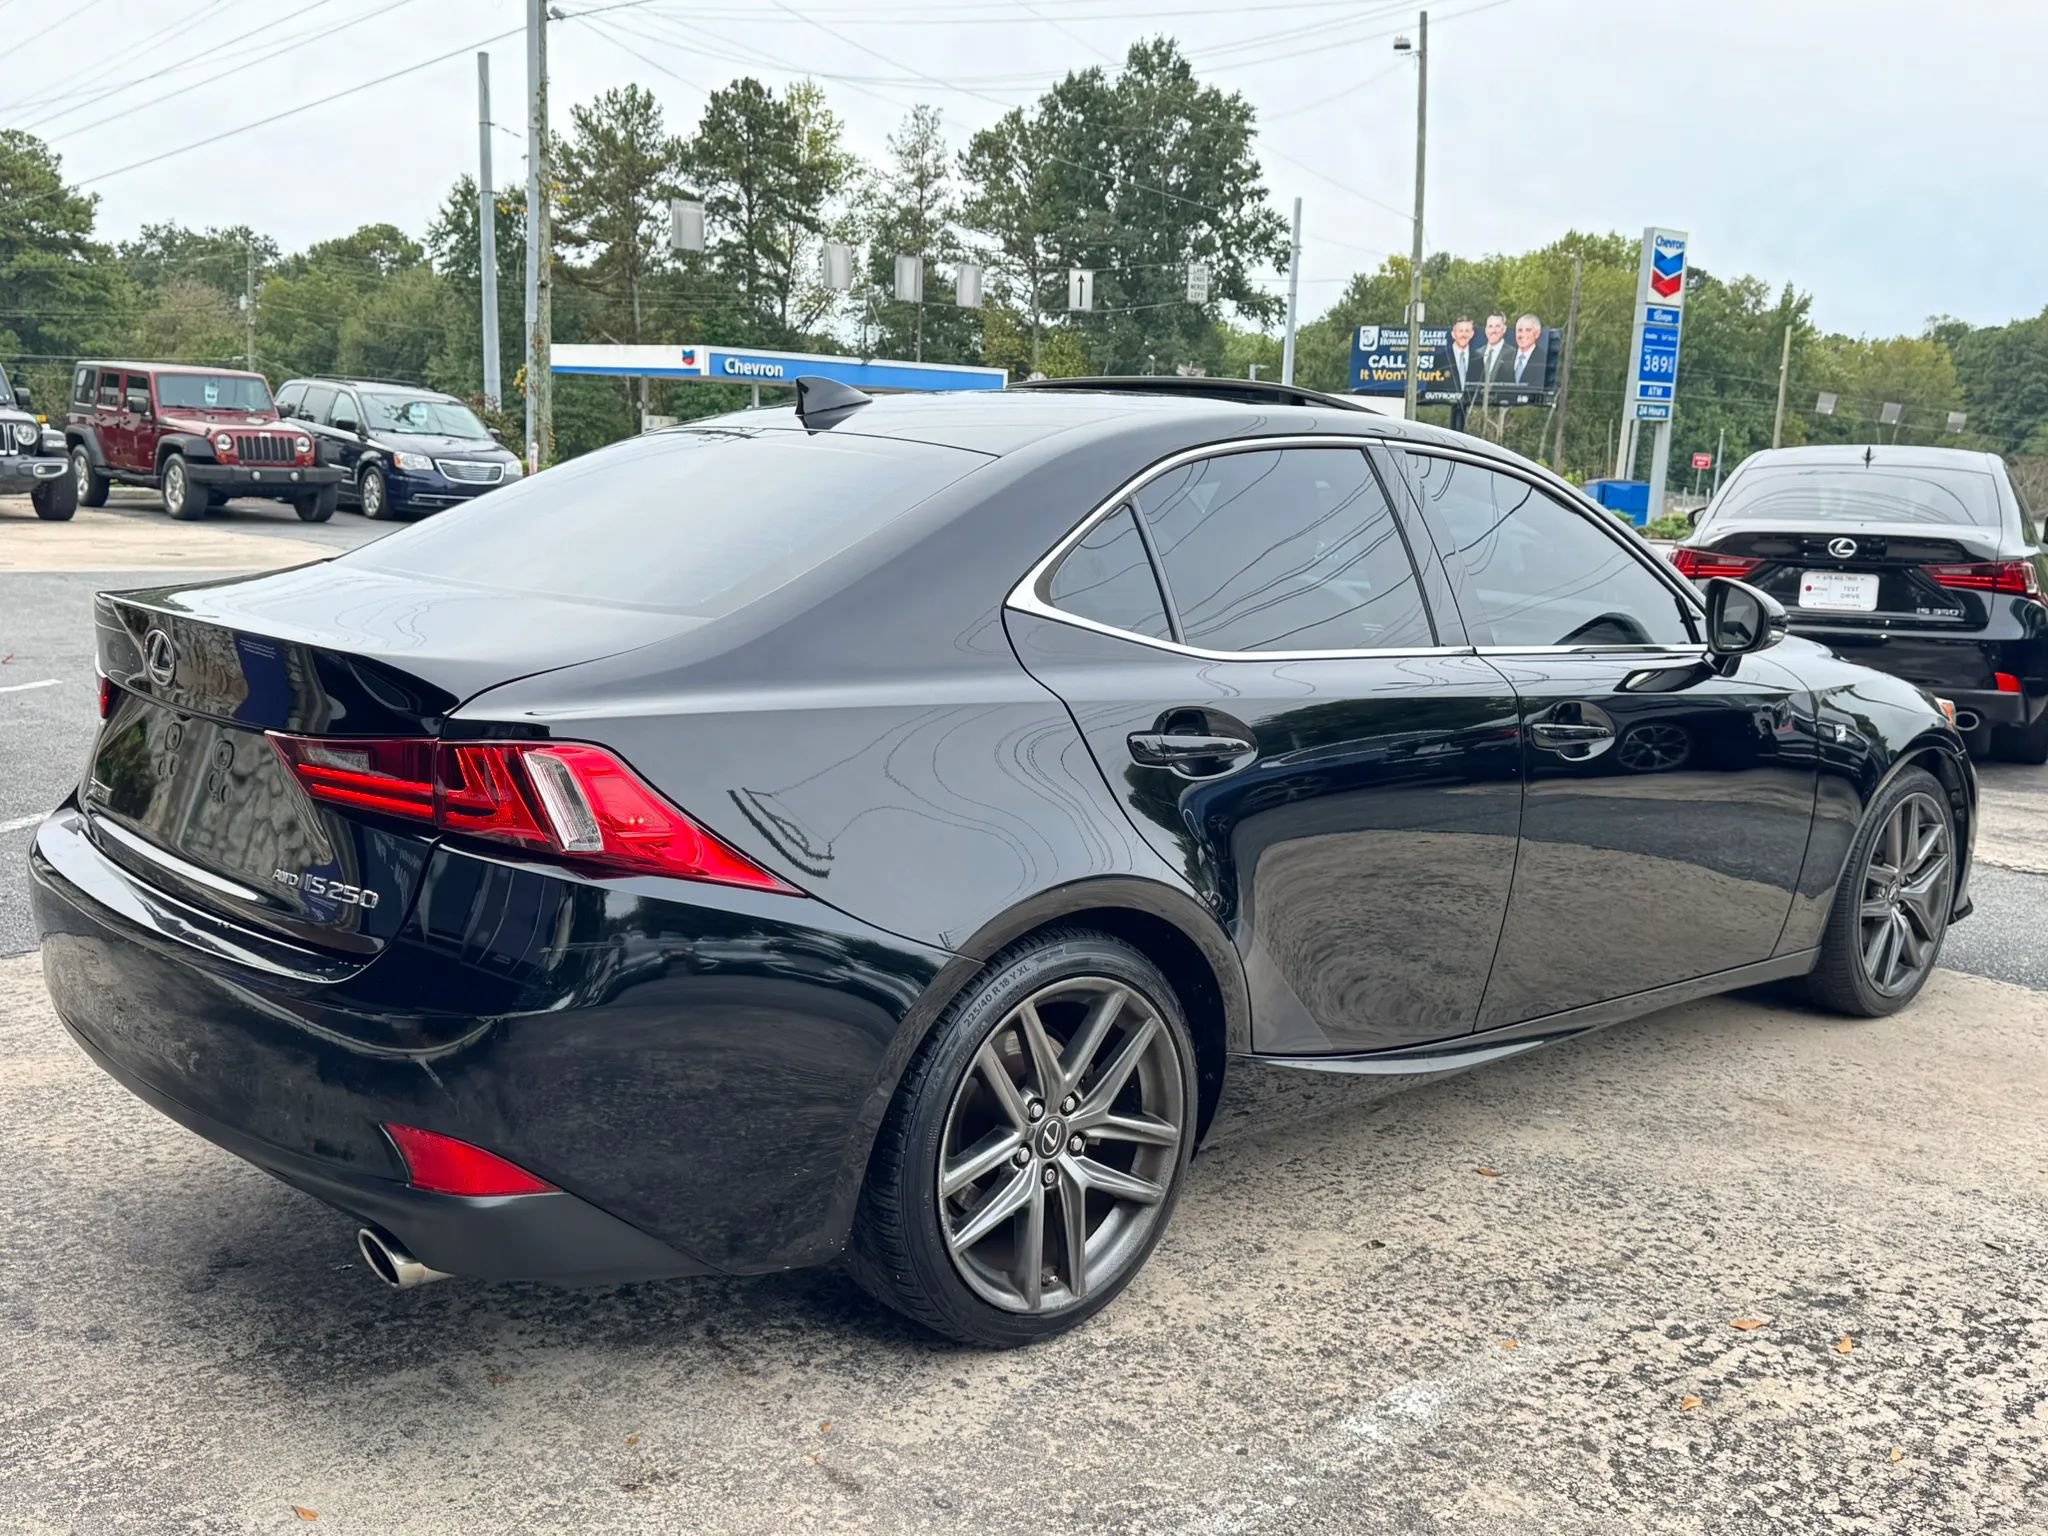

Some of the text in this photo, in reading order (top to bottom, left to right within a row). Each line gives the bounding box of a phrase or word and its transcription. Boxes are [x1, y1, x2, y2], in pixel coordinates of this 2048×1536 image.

[1656, 235, 1685, 249] Chevron
[725, 358, 783, 377] Chevron
[1368, 355, 1406, 368] CALL
[1643, 355, 1668, 373] 389
[1360, 369, 1369, 380] It
[1648, 387, 1663, 396] ATM
[1638, 405, 1666, 417] 24 Hours
[1916, 607, 1960, 616] IS 350
[272, 868, 299, 886] AWD
[963, 993, 993, 1028] 225/40
[991, 986, 1001, 996] R
[998, 978, 1010, 990] 18
[1016, 964, 1031, 974] XL
